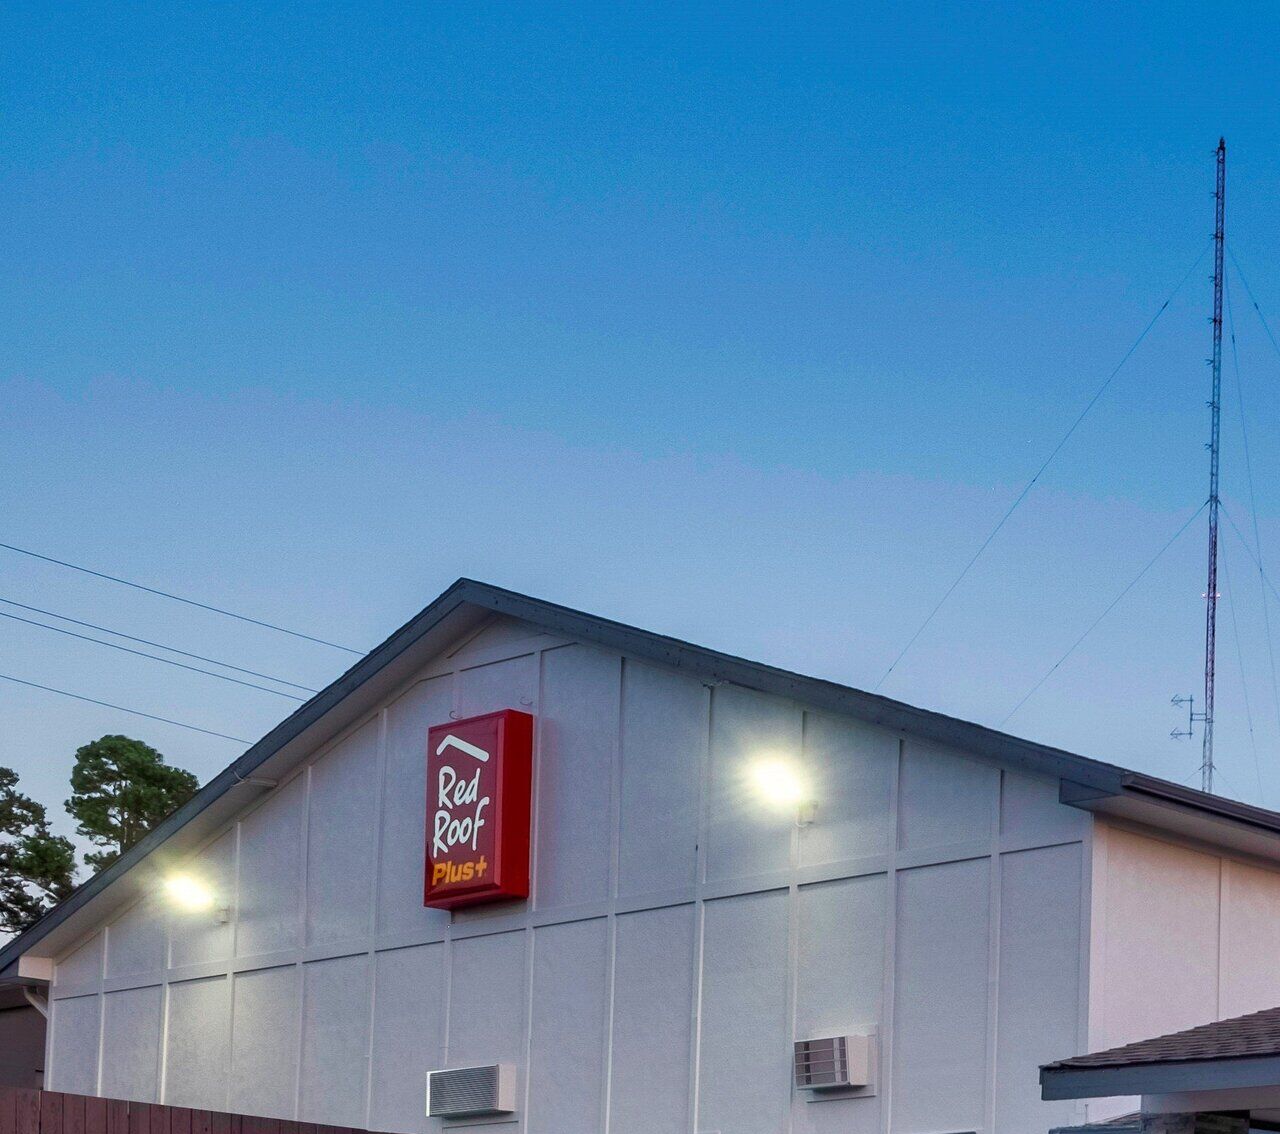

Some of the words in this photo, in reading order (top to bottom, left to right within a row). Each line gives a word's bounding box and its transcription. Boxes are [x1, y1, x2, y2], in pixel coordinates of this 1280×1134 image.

[438, 765, 481, 810] Red
[433, 796, 490, 859] Roof
[431, 855, 487, 886] Plus+
